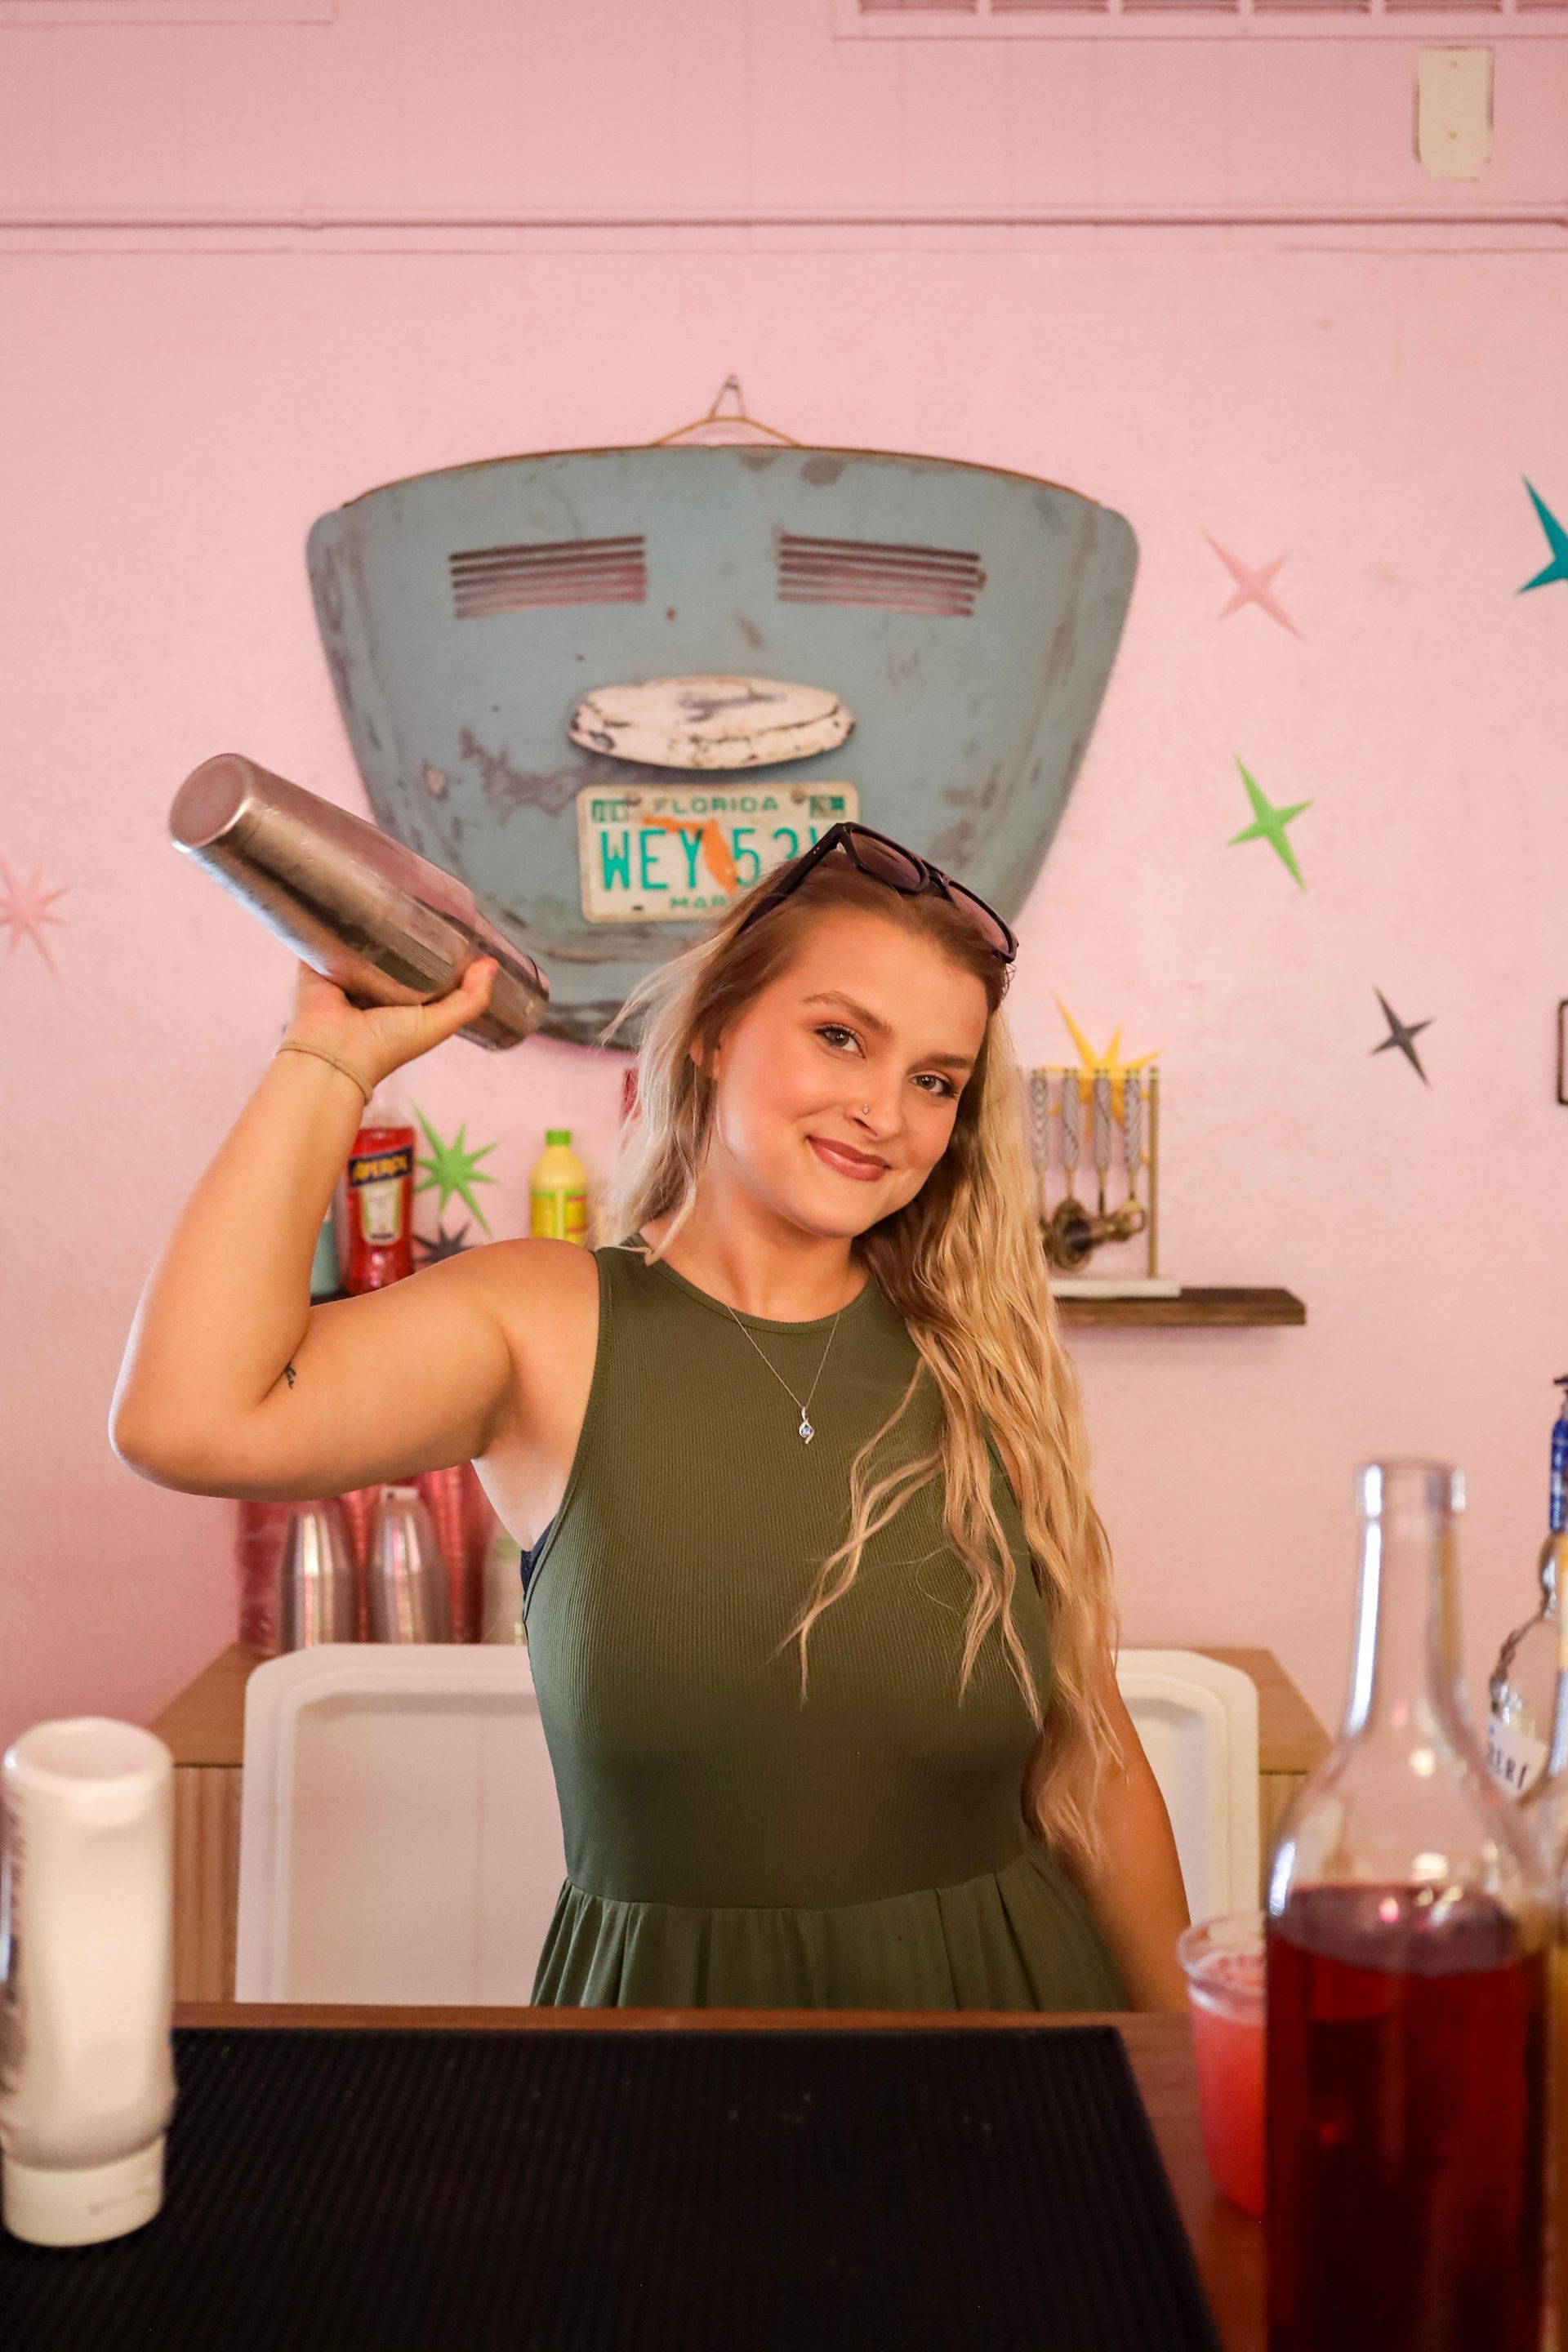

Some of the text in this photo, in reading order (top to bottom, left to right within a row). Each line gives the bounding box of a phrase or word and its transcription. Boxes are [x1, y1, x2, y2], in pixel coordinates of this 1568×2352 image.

[656, 796, 778, 814] FLORIDA
[600, 828, 705, 889] WEY
[670, 895, 726, 908] MAR
